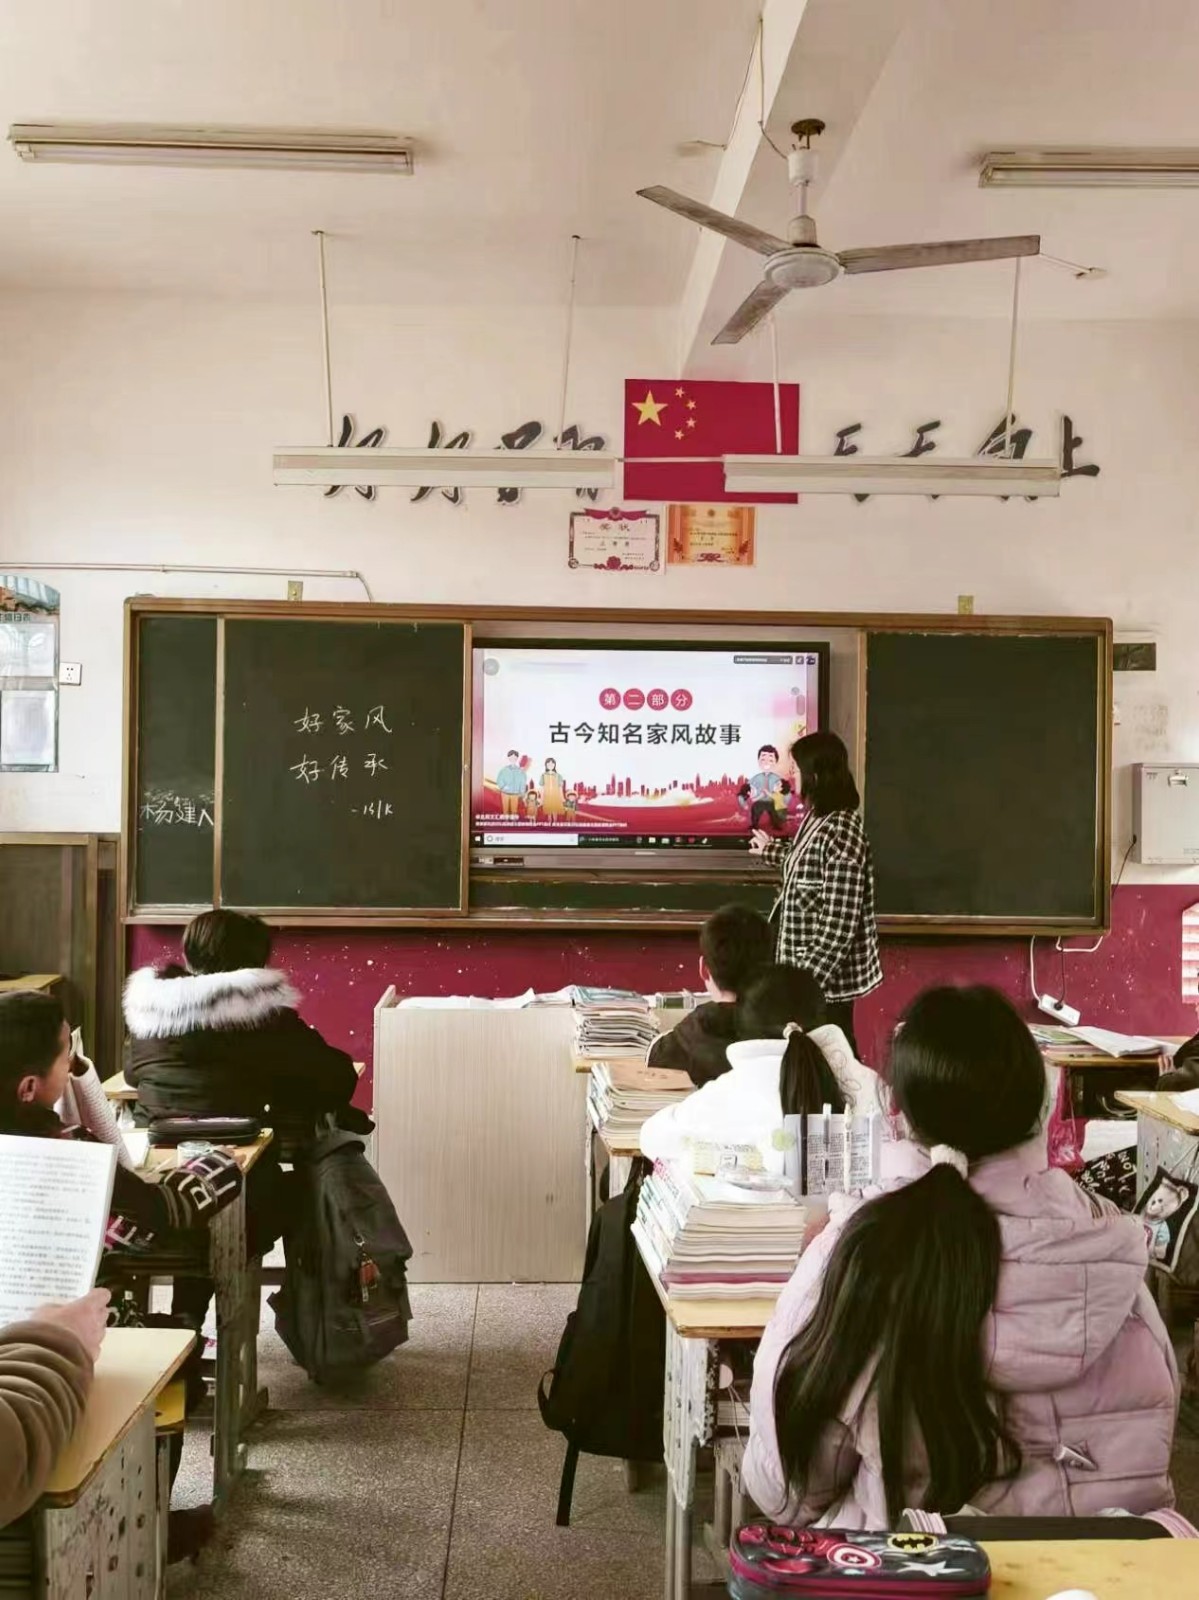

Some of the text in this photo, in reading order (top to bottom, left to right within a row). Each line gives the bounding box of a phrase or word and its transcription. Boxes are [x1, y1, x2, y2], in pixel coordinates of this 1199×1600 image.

[603, 691, 691, 708] 第二部分
[294, 706, 393, 735] 好家风
[549, 721, 741, 745] 古今知名家风故事
[290, 754, 388, 784] 好传承
